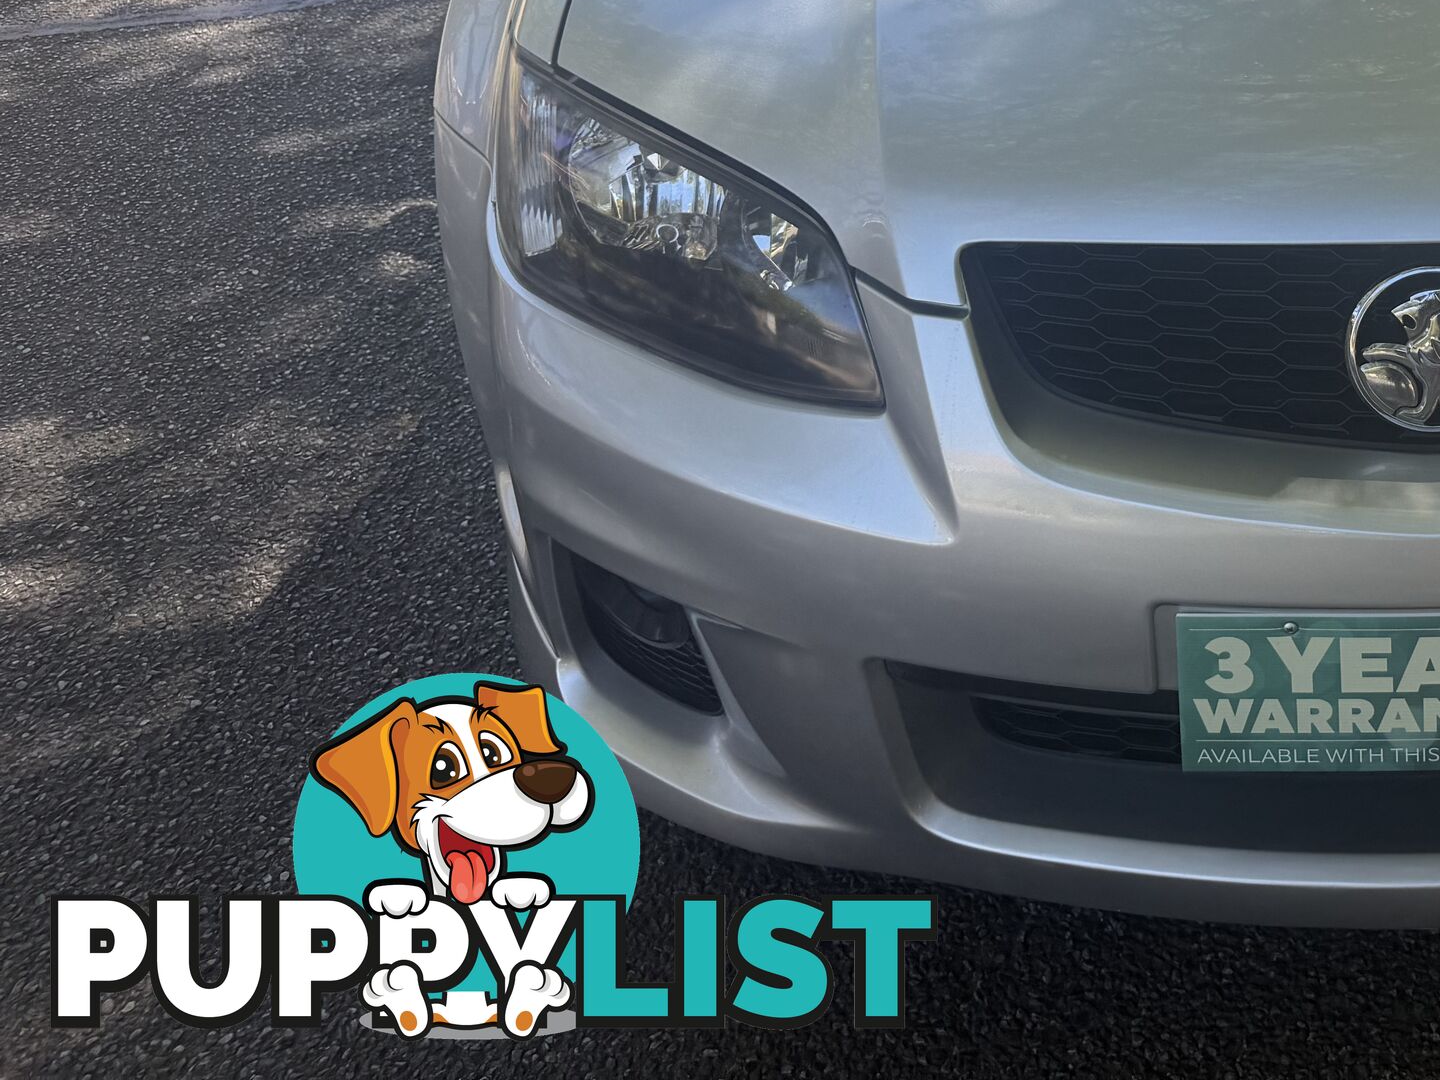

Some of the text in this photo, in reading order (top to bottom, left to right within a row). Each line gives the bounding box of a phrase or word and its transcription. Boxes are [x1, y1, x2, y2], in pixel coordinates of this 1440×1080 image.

[1204, 636, 1254, 694] 3
[1197, 748, 1320, 764] AVAILABLE
[1325, 748, 1384, 764] WITH
[1390, 747, 1440, 763] THIS
